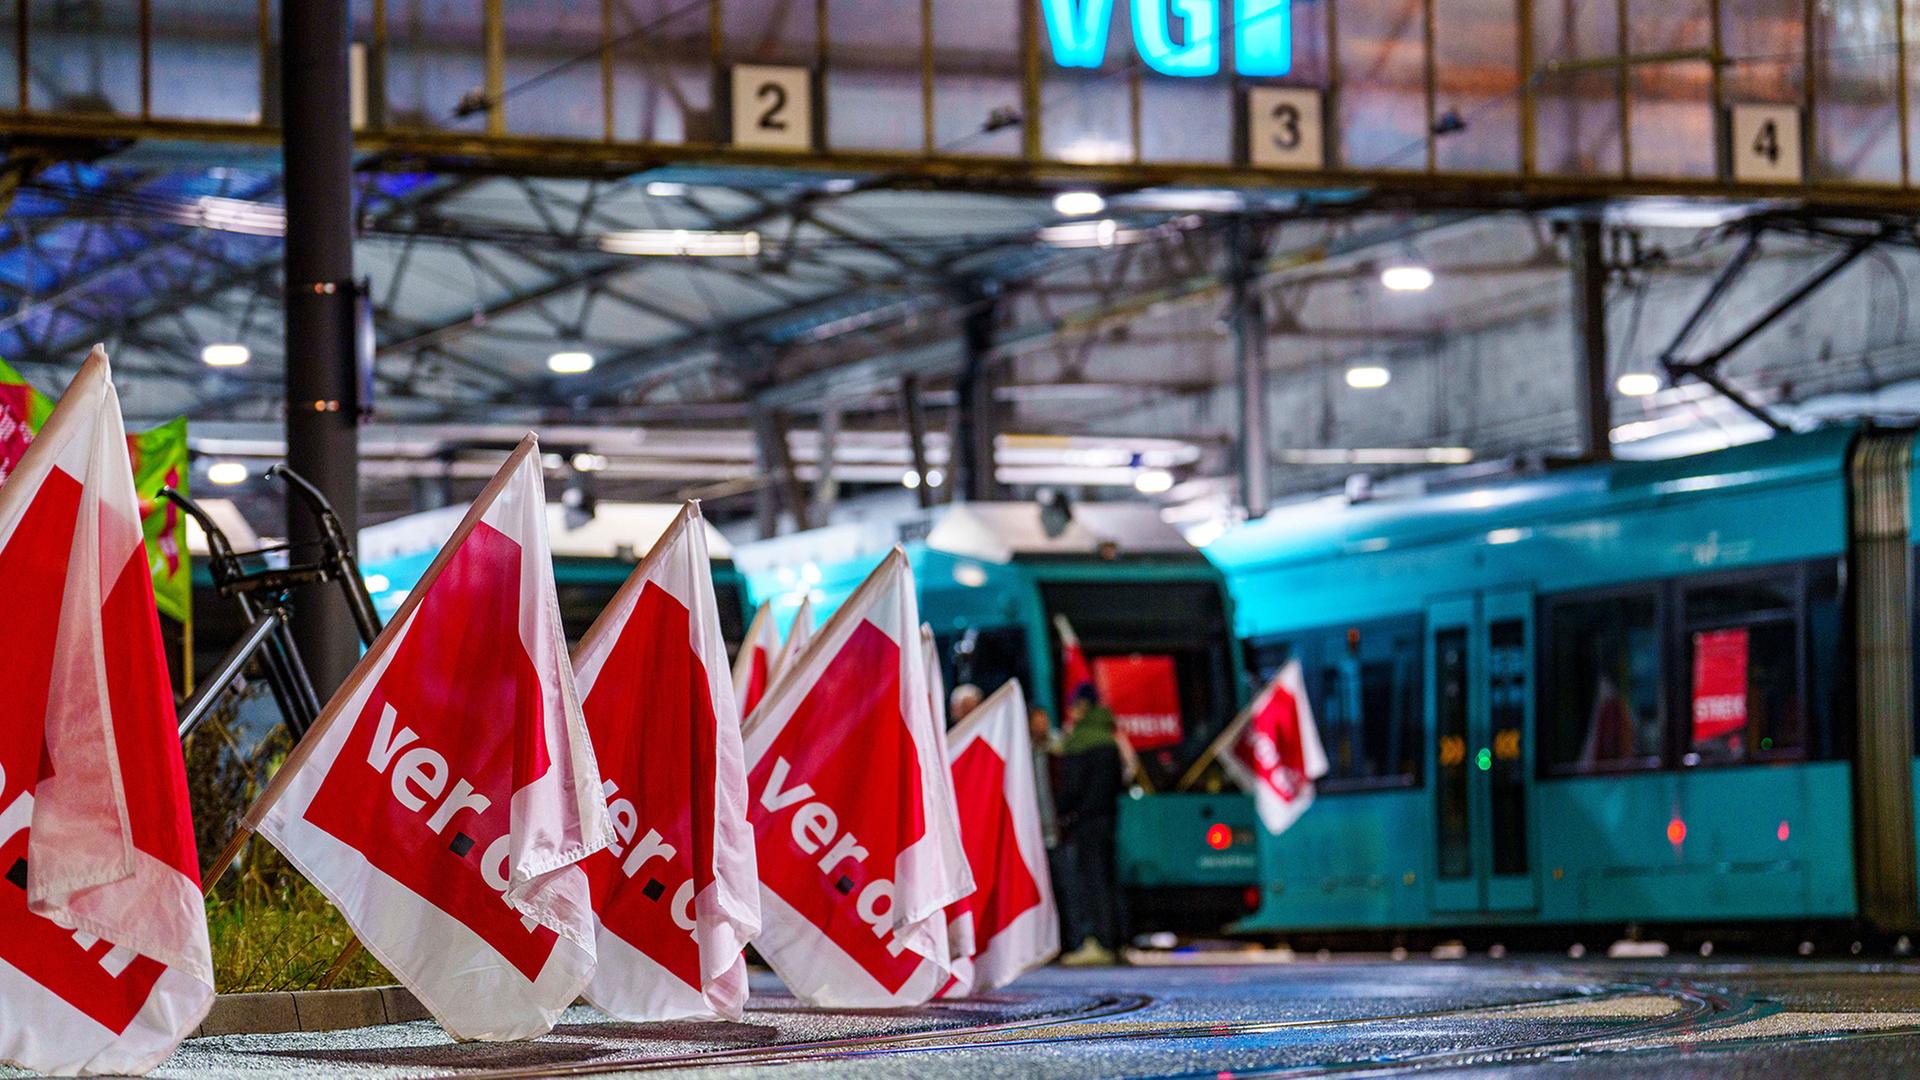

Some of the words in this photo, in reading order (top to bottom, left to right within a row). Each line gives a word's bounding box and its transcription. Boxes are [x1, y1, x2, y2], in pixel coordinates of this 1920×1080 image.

[756, 82, 786, 130] 2
[1272, 103, 1302, 150] 3
[1753, 120, 1779, 163] 4
[367, 701, 540, 934] ver.
